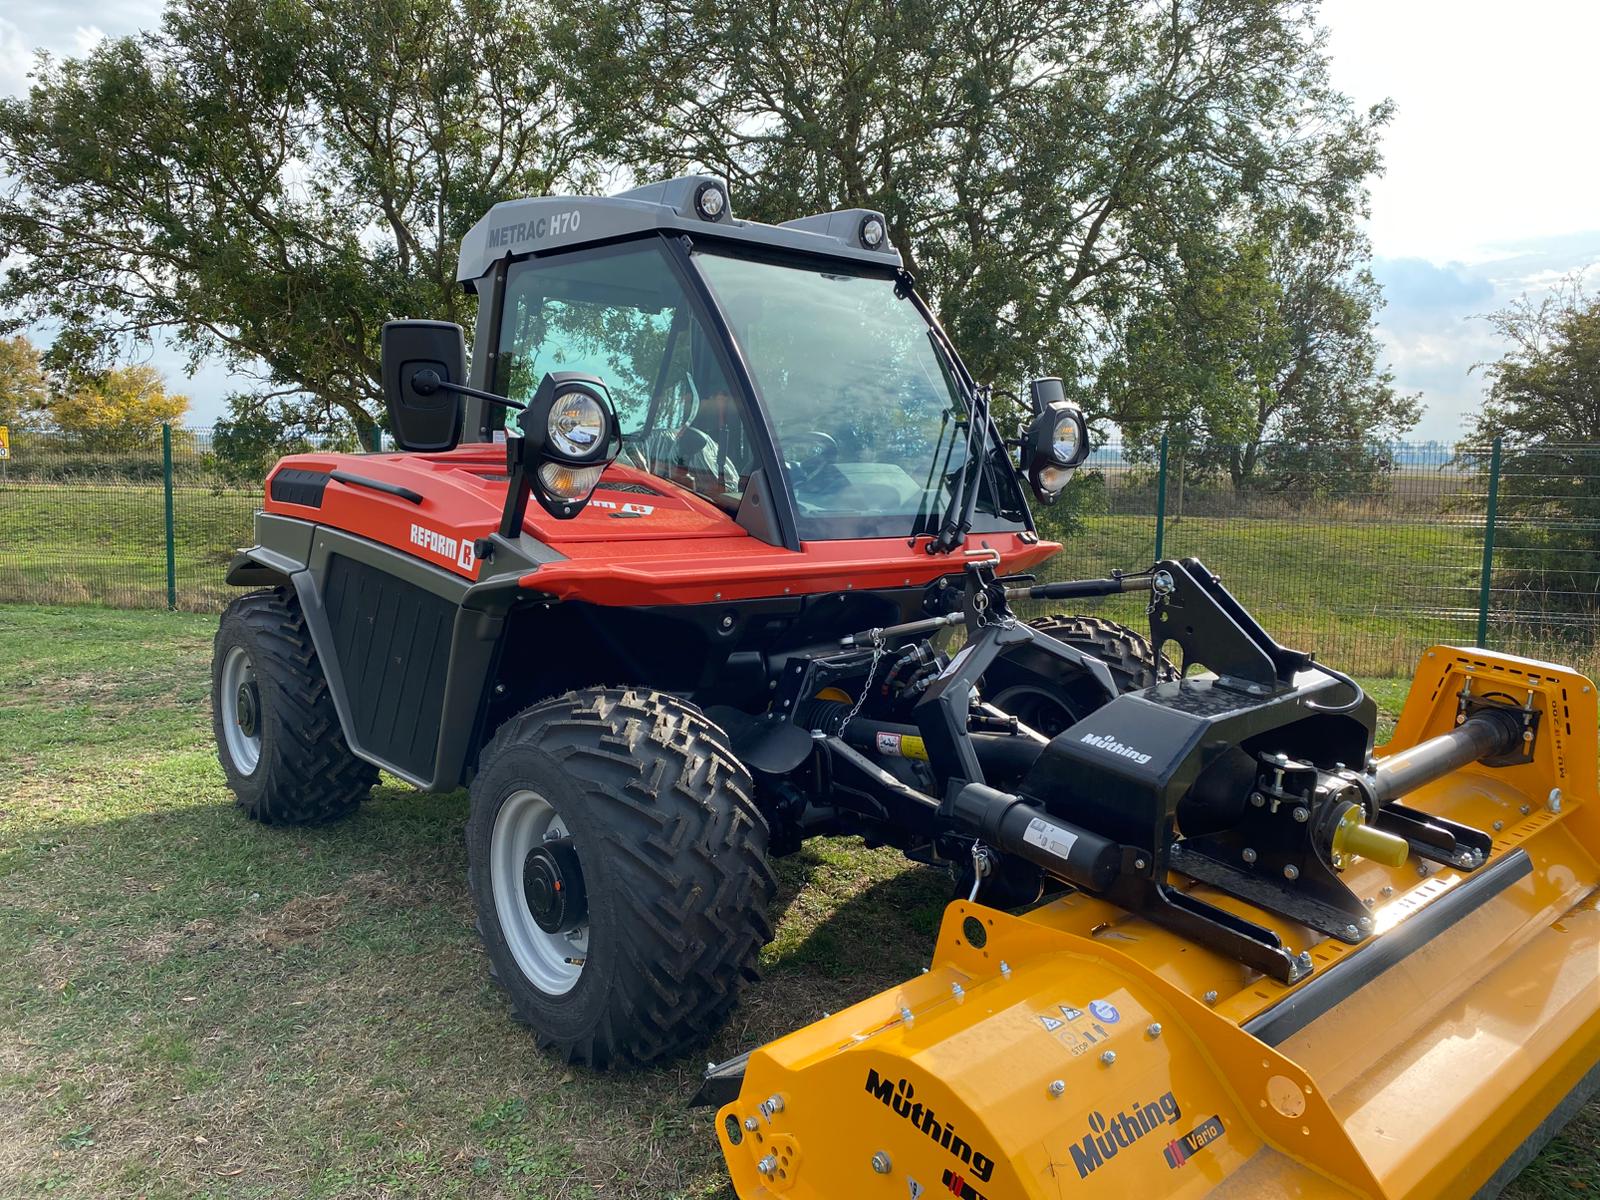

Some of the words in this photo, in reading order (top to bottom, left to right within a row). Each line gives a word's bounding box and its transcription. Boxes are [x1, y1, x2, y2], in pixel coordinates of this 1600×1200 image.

[489, 219, 546, 248] METRAC
[550, 210, 580, 235] H70
[410, 524, 457, 560] REFORM
[1081, 733, 1152, 764] Müthing
[1071, 1041, 1089, 1055] STOP
[866, 1068, 994, 1182] Müthing
[1069, 1091, 1182, 1179] Müthing
[1187, 1124, 1218, 1151] Vario
